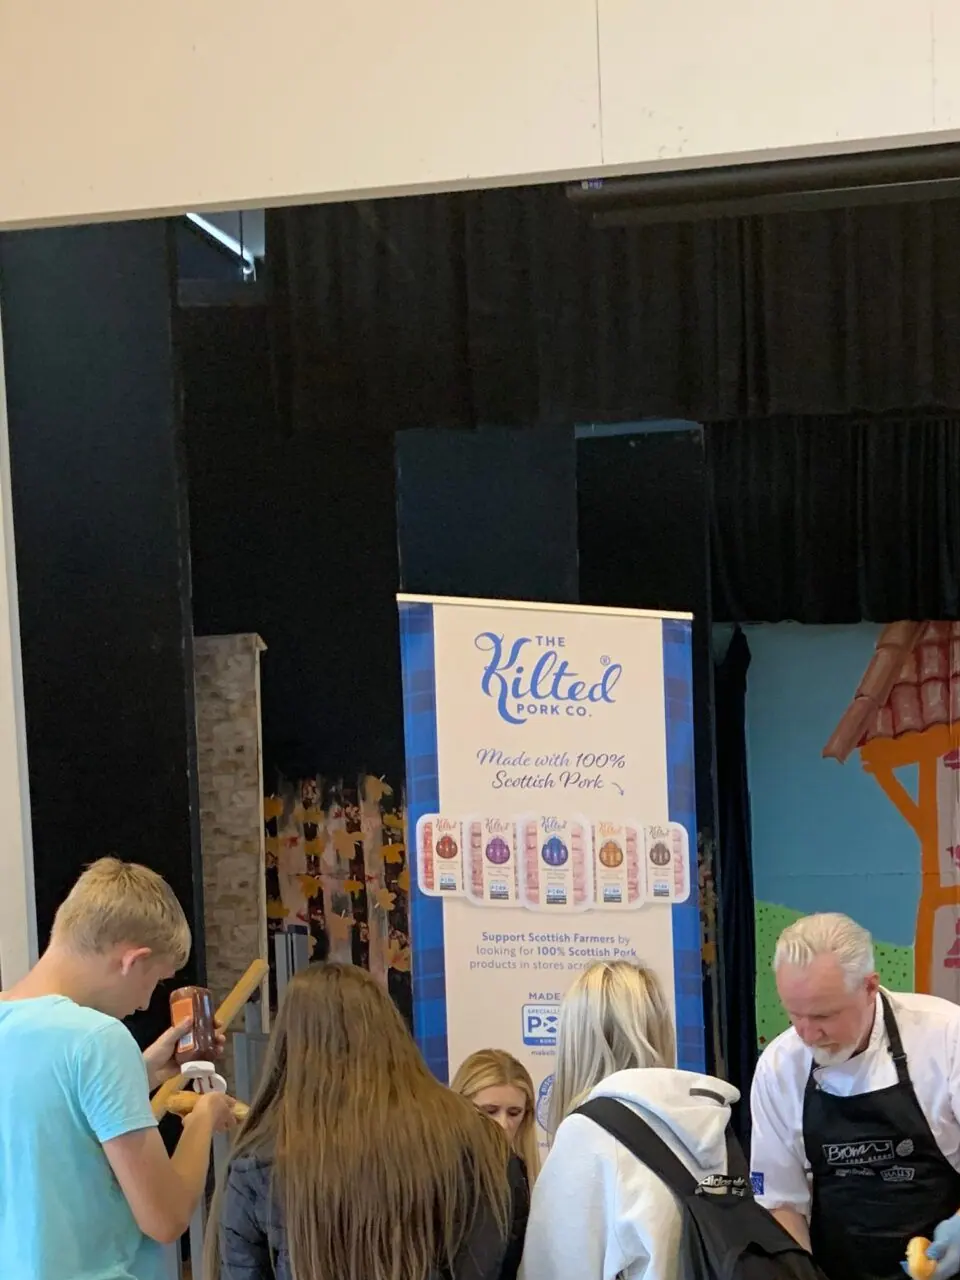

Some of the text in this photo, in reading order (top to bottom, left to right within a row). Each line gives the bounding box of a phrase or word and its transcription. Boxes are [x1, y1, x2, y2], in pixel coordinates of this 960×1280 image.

[535, 635, 565, 647] THE
[474, 631, 623, 725] Kilted
[516, 704, 592, 718] PORK CO.
[476, 748, 626, 769] Made with 100%
[492, 770, 604, 789] Scottish Pork
[482, 932, 630, 946] Support Scottish Farmers by
[476, 946, 637, 958] looking for 100% Scottish Pork
[469, 960, 517, 970] products
[520, 960, 530, 969] in
[533, 961, 564, 970] stores
[528, 992, 561, 1001] MADE
